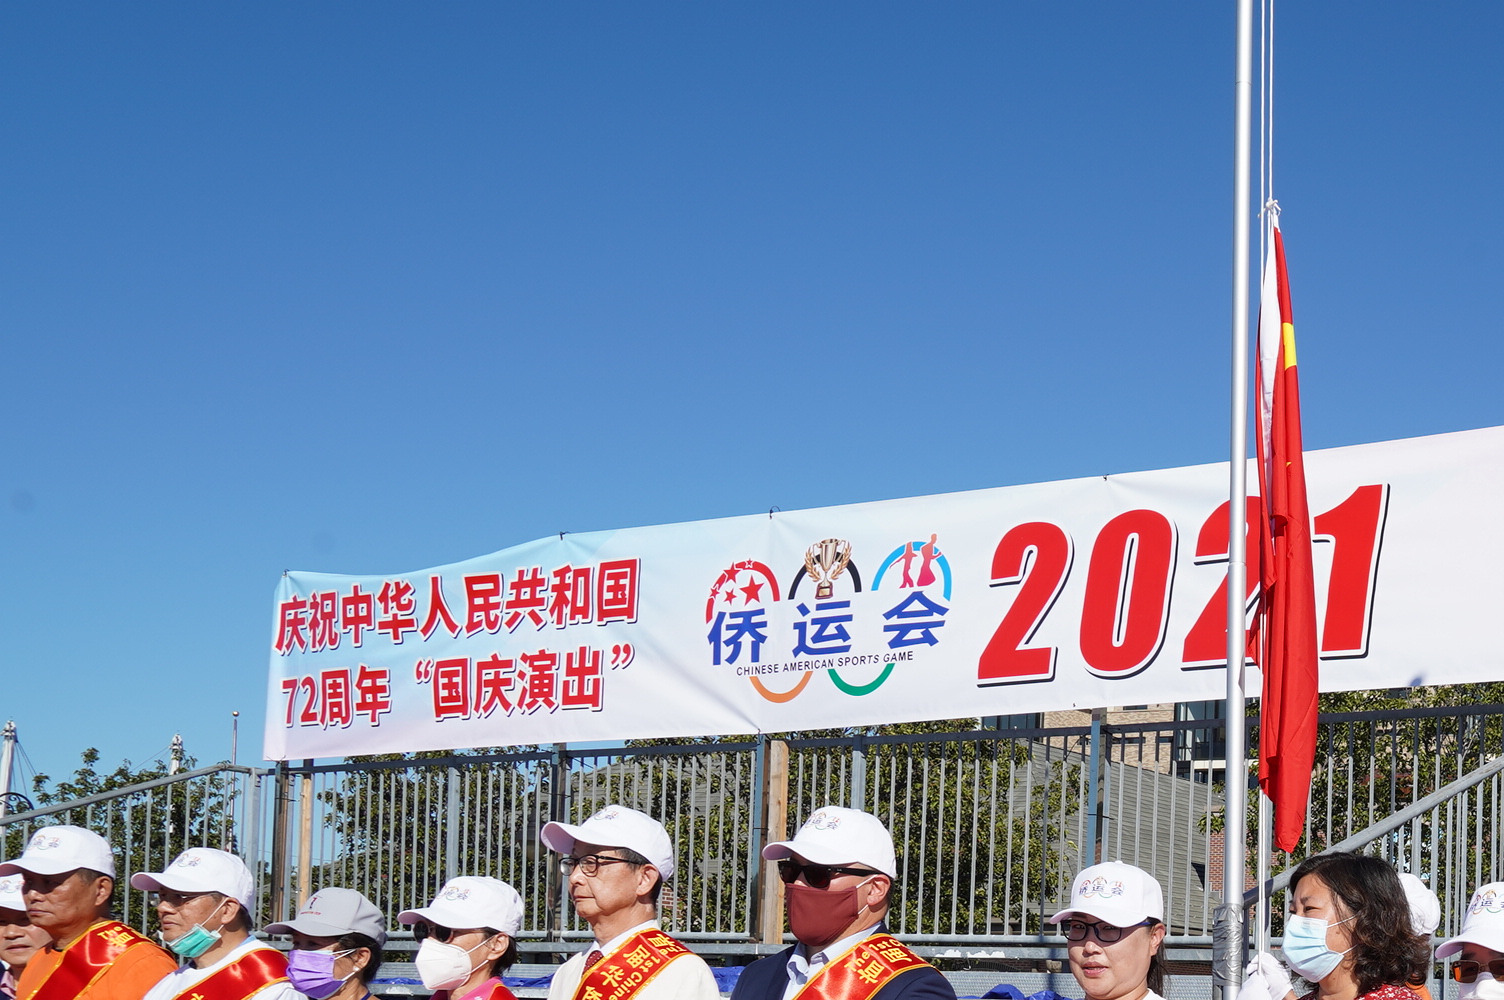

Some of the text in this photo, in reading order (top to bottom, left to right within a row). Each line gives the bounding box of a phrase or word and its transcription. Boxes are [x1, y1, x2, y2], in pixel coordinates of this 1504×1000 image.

[274, 556, 641, 654] 庆祝中华人民共和国
[977, 483, 1390, 687] 2021
[707, 590, 950, 666] 侨运会
[736, 650, 914, 676] CHINESE AMERICAN SPORTS GAME
[280, 664, 391, 729] 72周年
